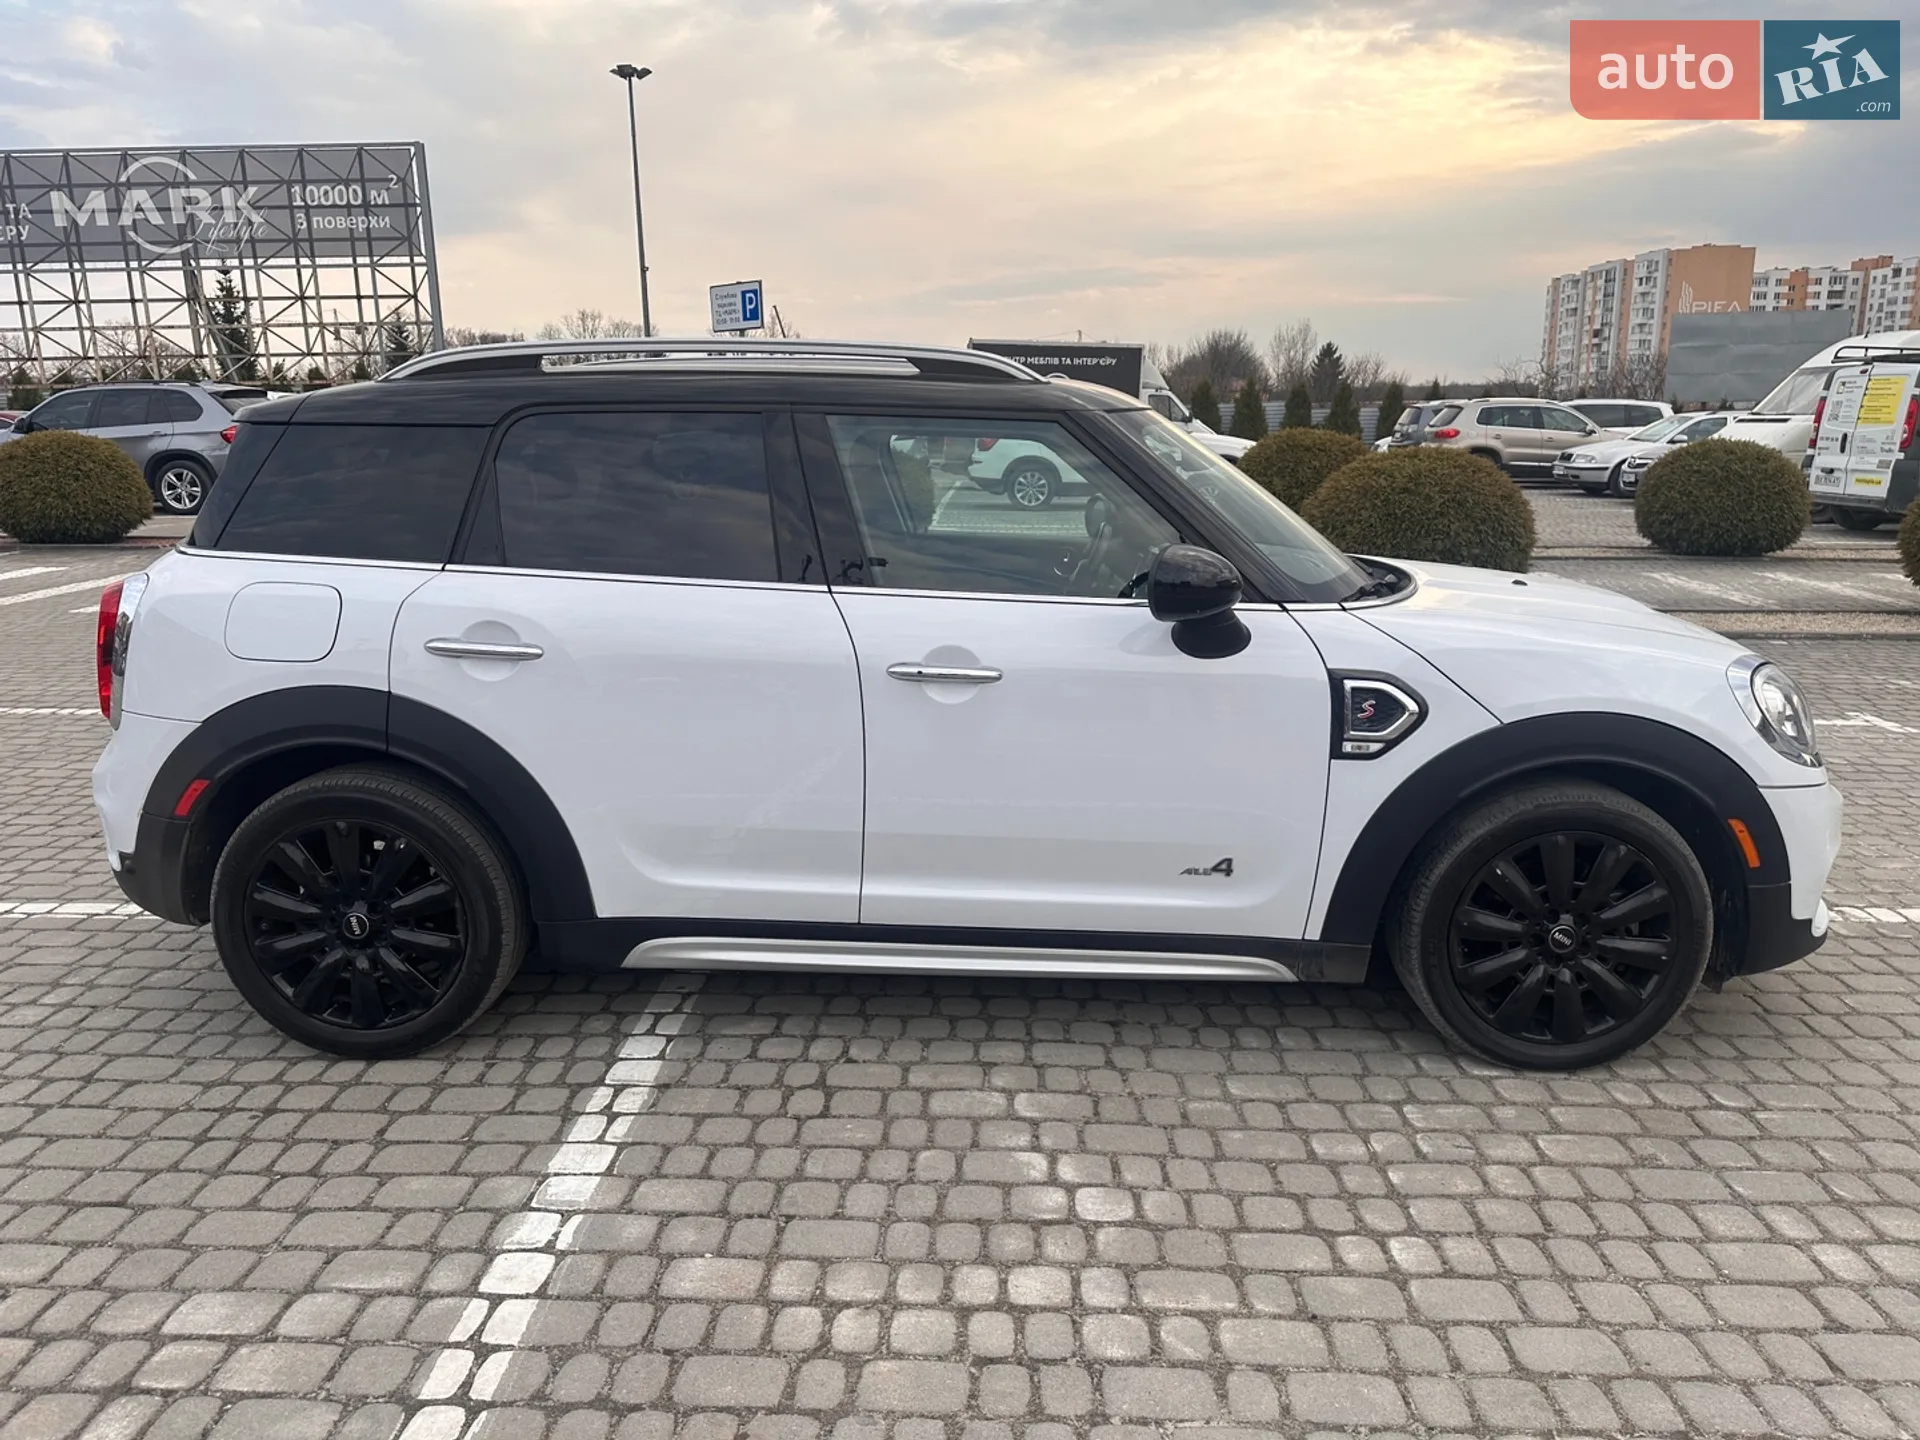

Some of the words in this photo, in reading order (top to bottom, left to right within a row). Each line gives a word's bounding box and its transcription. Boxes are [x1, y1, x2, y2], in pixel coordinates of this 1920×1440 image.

[291, 185, 363, 206] 10000
[5, 202, 32, 219] ТА
[50, 185, 265, 227] MARK
[296, 213, 307, 229] 3
[313, 214, 391, 233] поверхи
[745, 292, 756, 319] P
[1026, 356, 1060, 365] МЕБЛІВ
[1061, 357, 1072, 365] ТА
[1357, 699, 1376, 720] S
[1553, 931, 1572, 947] MINI
